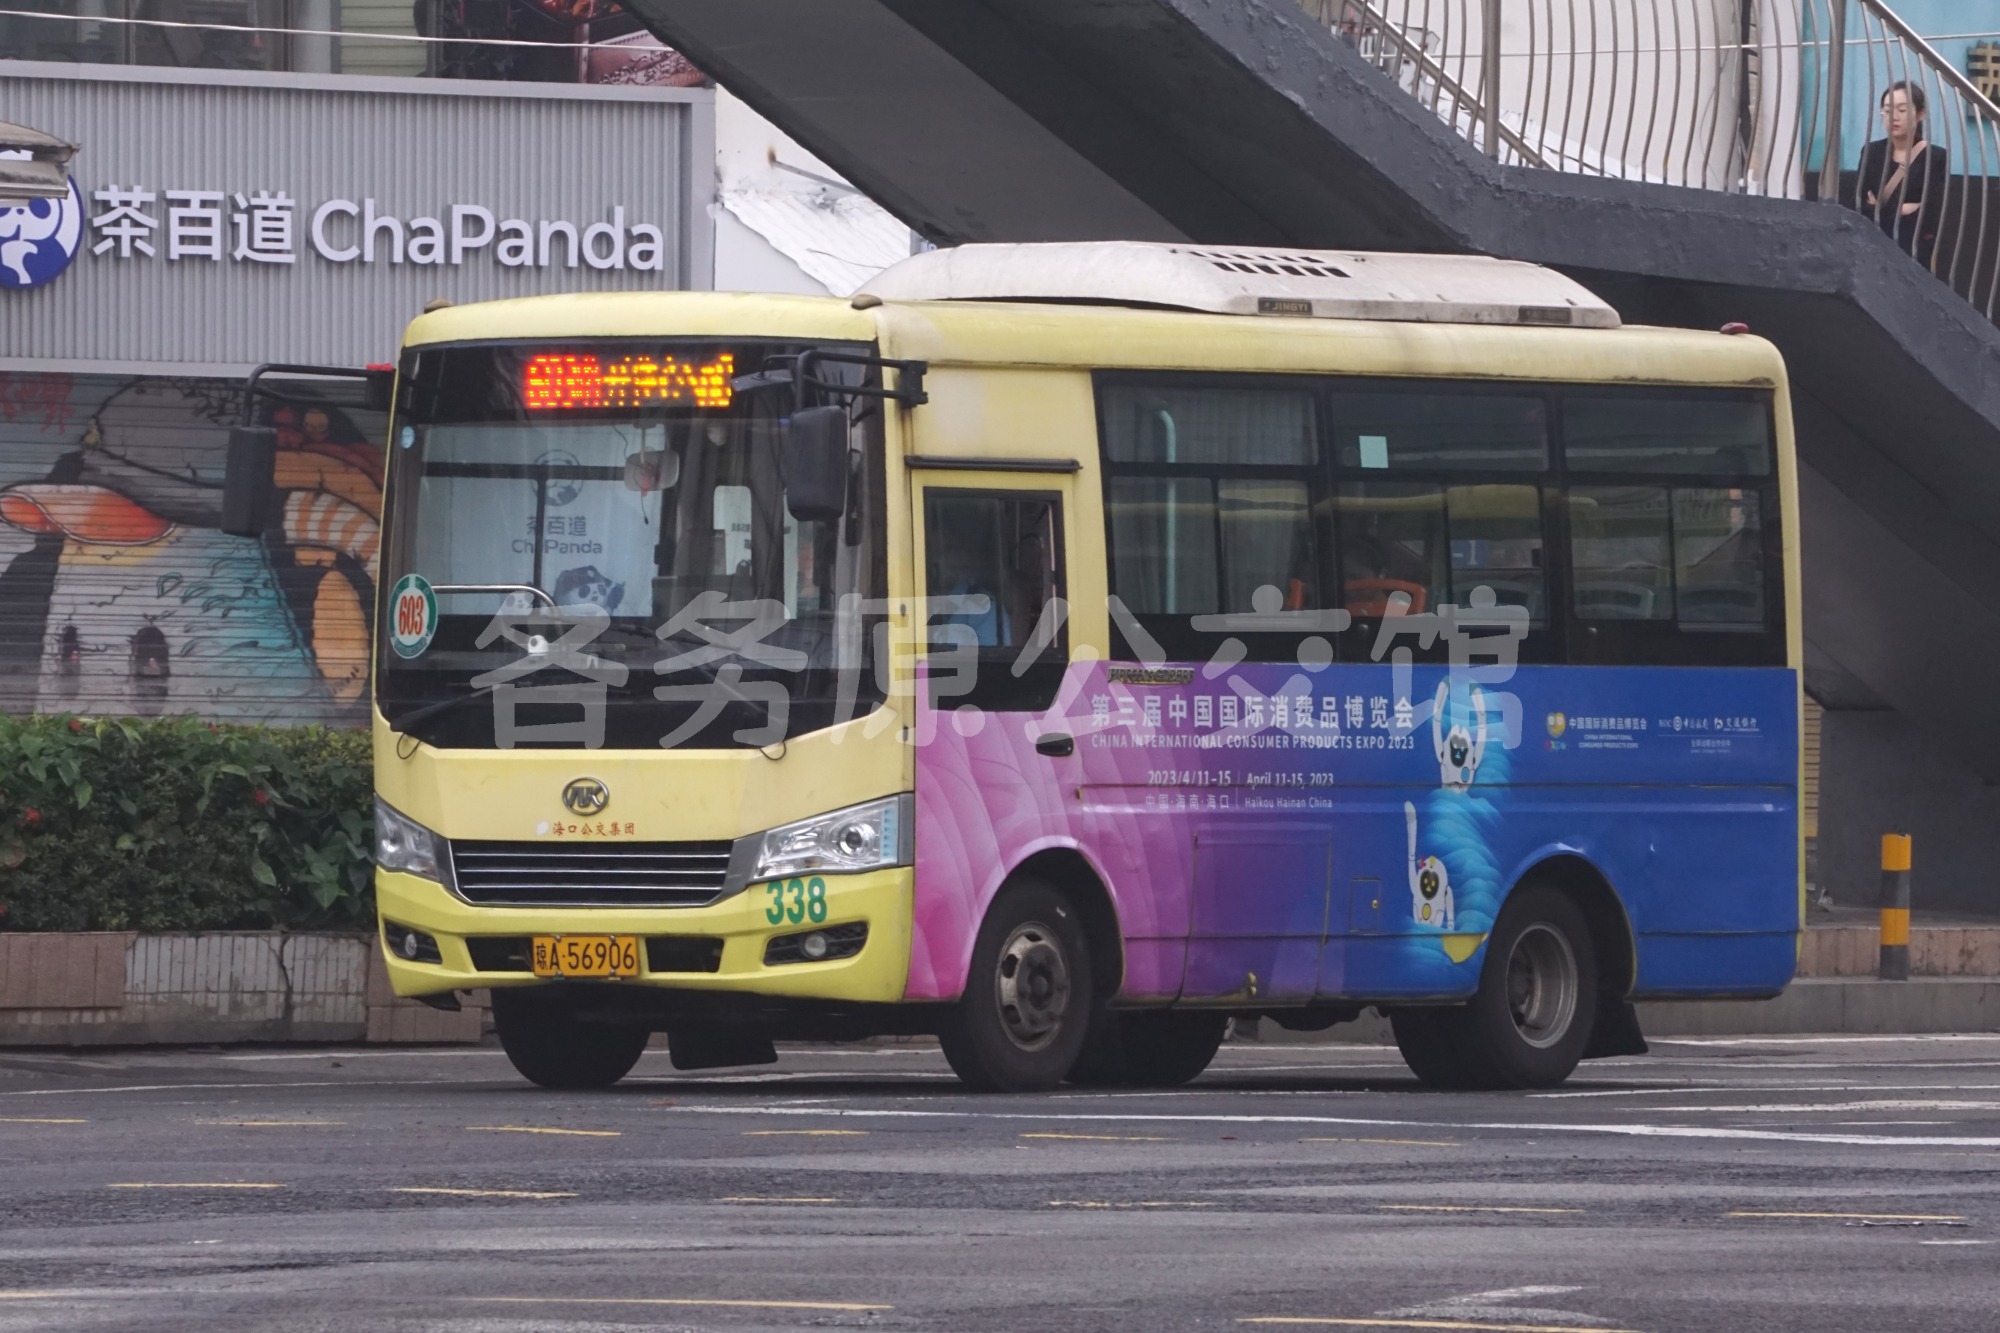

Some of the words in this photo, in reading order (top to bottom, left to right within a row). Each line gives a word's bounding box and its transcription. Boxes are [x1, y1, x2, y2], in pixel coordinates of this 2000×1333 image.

[90, 184, 297, 264] 茶百道
[310, 198, 665, 272] ChaPanda
[1272, 302, 1308, 312] JINGYI
[511, 537, 603, 554] ChPanda
[398, 595, 425, 637] 603
[1091, 693, 1414, 729] 第三届中国国际消费品博览会
[1091, 734, 1128, 748] CHINA
[1131, 734, 1223, 749] INTERNATIONAL
[1226, 735, 1289, 749] CONSUMER
[1292, 735, 1353, 749] PRODUCTS
[1356, 736, 1385, 749] EXPO
[1387, 736, 1415, 749] 2023
[1147, 770, 1232, 786] 2023/4/11-15
[1246, 772, 1272, 790] April
[1310, 773, 1335, 786] 2023
[1244, 796, 1274, 808] Haikou
[1276, 796, 1307, 808] Hainan
[1308, 796, 1333, 808] China
[552, 821, 636, 837] 海口公交集团
[765, 876, 828, 926] 338
